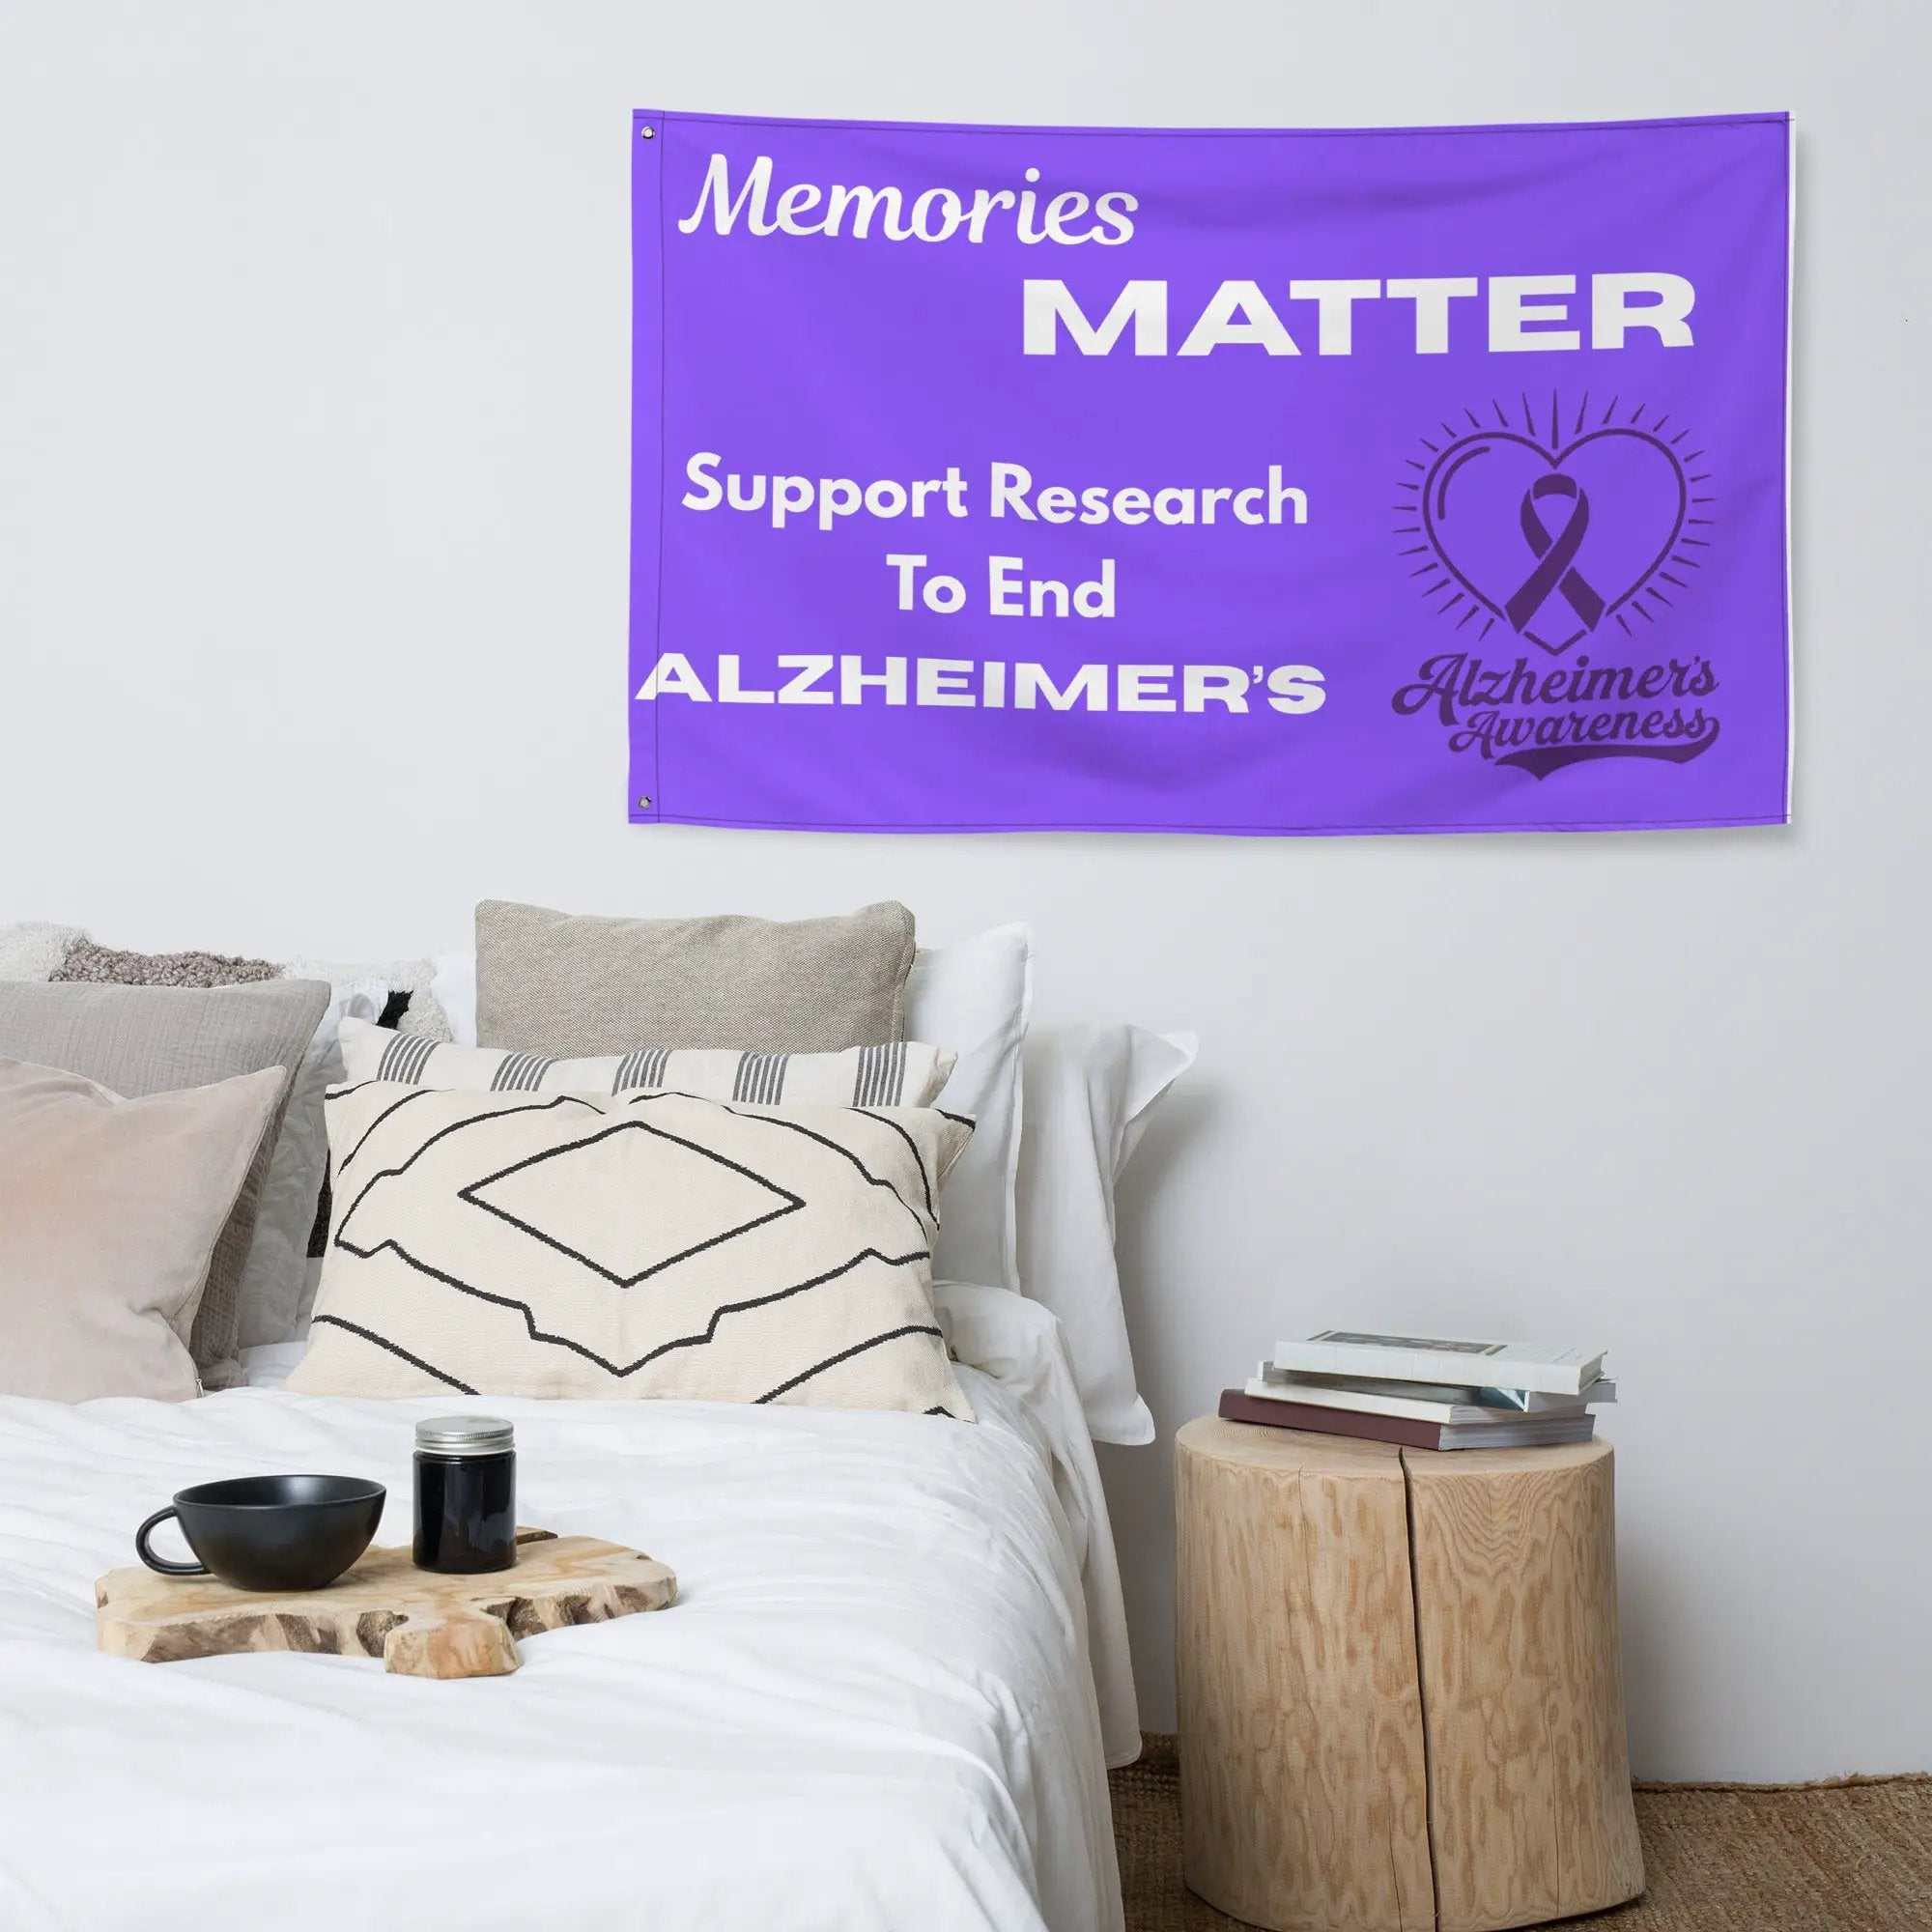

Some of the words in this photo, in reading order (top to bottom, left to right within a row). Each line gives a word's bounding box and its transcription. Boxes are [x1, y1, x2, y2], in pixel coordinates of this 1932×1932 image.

[678, 153, 1139, 245] Memories
[1023, 271, 1696, 356] MATTER
[681, 451, 969, 531] Support
[990, 462, 1308, 526] Research
[886, 554, 967, 614] To
[988, 555, 1116, 618] End
[635, 652, 1326, 715] ALZHEIMER'S
[1391, 652, 1719, 726] Alzheimer's
[1448, 707, 1720, 760] Awareness
